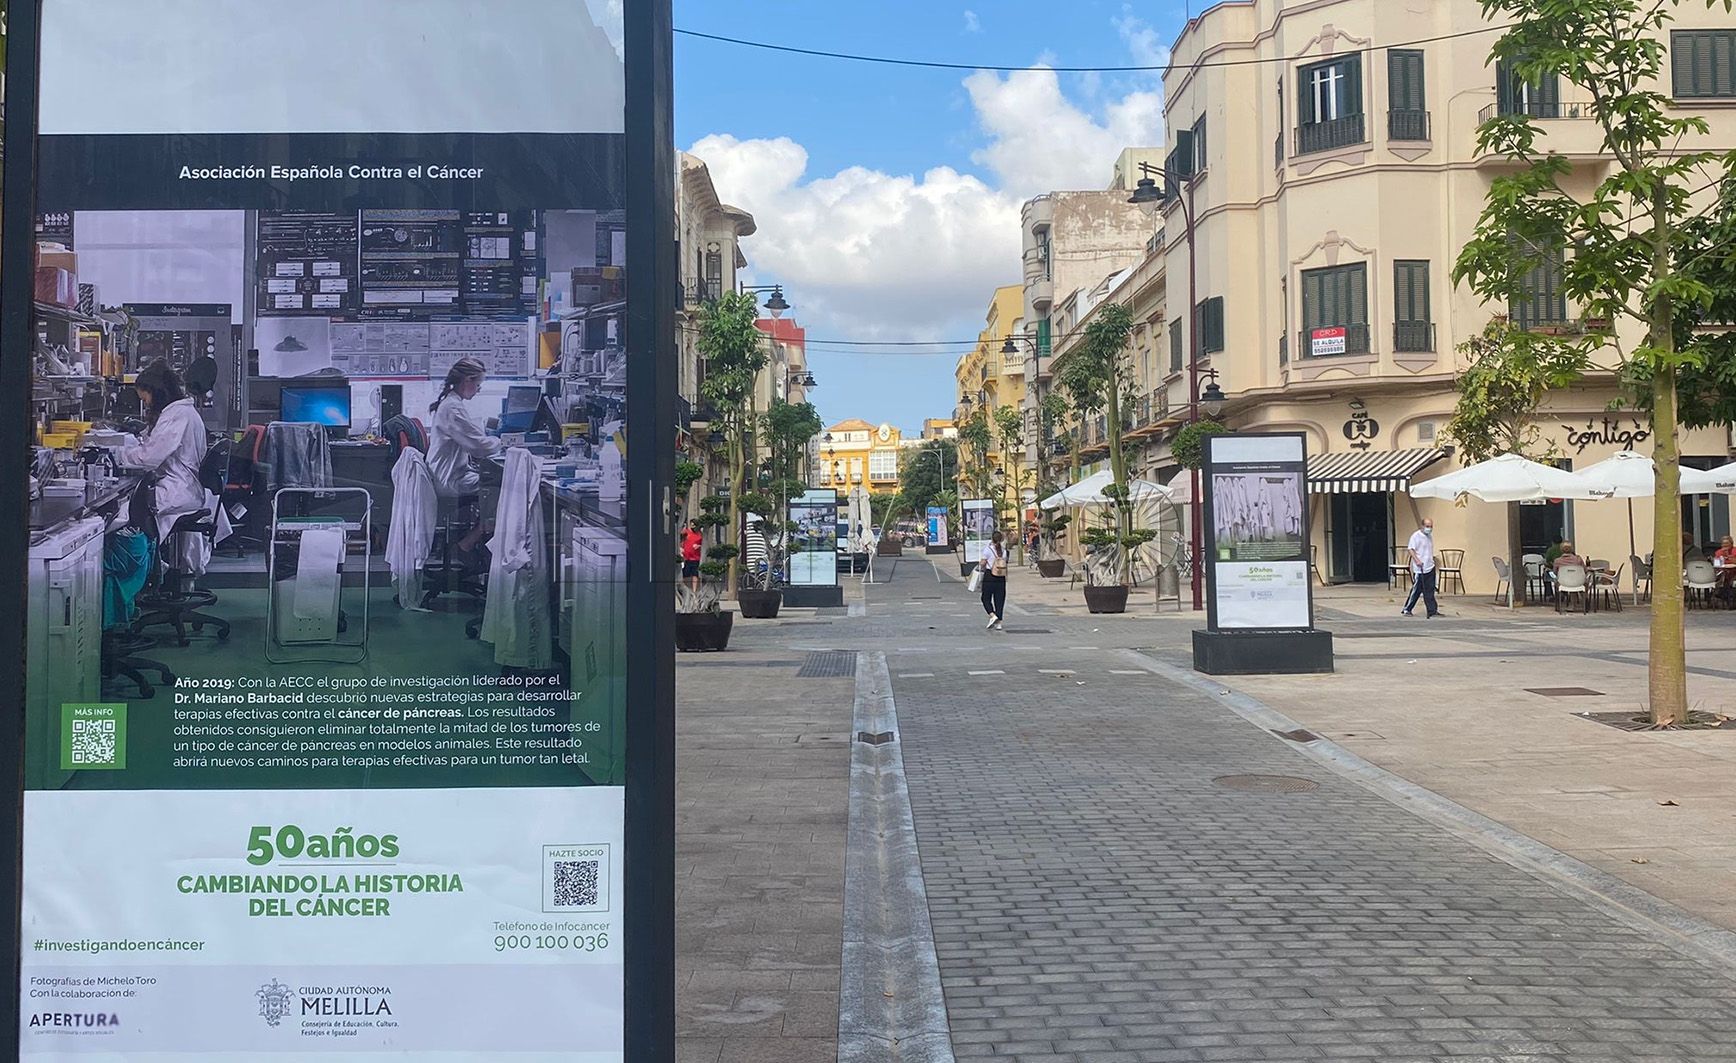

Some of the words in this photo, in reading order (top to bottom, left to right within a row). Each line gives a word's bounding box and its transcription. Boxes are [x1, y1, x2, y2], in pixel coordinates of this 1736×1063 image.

[178, 164, 265, 178] Asociación
[270, 164, 342, 181] Española
[348, 165, 402, 178] Contra
[407, 165, 421, 178] el
[426, 164, 483, 178] Cáncer
[1566, 417, 1652, 451] contigo
[174, 676, 199, 687] Año
[202, 678, 234, 690] 2019:
[238, 676, 262, 688] Con
[265, 676, 276, 687] la
[278, 676, 313, 687] AECC
[316, 676, 328, 687] el
[330, 678, 367, 690] grupo
[370, 675, 387, 687] de
[390, 675, 469, 689] investigación
[472, 674, 522, 685] liderado
[525, 676, 545, 687] por
[548, 674, 560, 685] el
[174, 692, 191, 703] Dr.
[194, 692, 244, 704] Mariano
[247, 692, 303, 703] Barbacid
[306, 691, 367, 703] descubrió
[370, 693, 414, 703] nuevas
[417, 690, 484, 705] estrategias
[487, 692, 513, 703] para
[516, 689, 582, 701] desarrollar
[74, 707, 92, 716] MÁS
[94, 708, 113, 716] INFO
[174, 708, 222, 721] terapias
[224, 707, 278, 719] efectivas
[281, 708, 320, 719] contra
[323, 708, 335, 719] el
[337, 707, 381, 718] cáncer
[383, 707, 400, 718] de
[403, 706, 464, 720] páncreas.
[467, 706, 489, 717] Los
[492, 705, 555, 717] resultados
[173, 724, 234, 735] obtenidos
[236, 723, 314, 738] consiguieron
[317, 723, 366, 734] eliminar
[369, 722, 436, 734] totalmente
[439, 722, 450, 733] la
[453, 722, 487, 733] mitad
[490, 721, 507, 733] de
[510, 721, 528, 732] los
[530, 721, 581, 732] tumores
[584, 720, 600, 731] de
[173, 742, 188, 751] un
[192, 739, 215, 753] tipo
[218, 739, 234, 751] de
[236, 739, 279, 751] cáncer
[281, 739, 297, 751] de
[300, 739, 356, 753] páncreas
[359, 741, 374, 750] en
[378, 738, 432, 750] modelos
[434, 737, 492, 749] animales.
[495, 737, 521, 748] Este
[524, 737, 582, 748] resultado
[172, 755, 207, 767] abrirá
[210, 757, 254, 766] nuevos
[257, 755, 308, 766] caminos
[311, 757, 338, 768] para
[342, 754, 390, 768] terapias
[392, 754, 448, 765] efectivas
[450, 755, 478, 767] para
[481, 755, 496, 764] un
[500, 753, 536, 764] tumor
[539, 753, 558, 764] tan
[561, 752, 590, 763] letal.
[549, 849, 576, 857] HAZTE
[577, 849, 604, 857] SOCIO
[177, 875, 318, 894] CAMBIANDO
[320, 875, 350, 893] LA
[354, 874, 463, 893] HISTORIA
[249, 898, 293, 916] DEL
[296, 894, 390, 916] CÁNCER
[539, 921, 553, 931] de
[34, 938, 205, 954] #investigandoencáncer
[494, 934, 531, 952] 900
[535, 935, 568, 949] 100
[573, 932, 608, 952] 036
[82, 976, 95, 986] de
[97, 976, 134, 985] Michelo
[135, 976, 156, 985] Toro
[29, 989, 48, 998] Con
[51, 988, 59, 998] la
[298, 987, 333, 995] CIUDAD
[335, 985, 392, 995] AUTÓNOMA
[300, 998, 392, 1015] MELILLA
[29, 1013, 120, 1027] APERTURA
[331, 1029, 357, 1037] Igualdad
